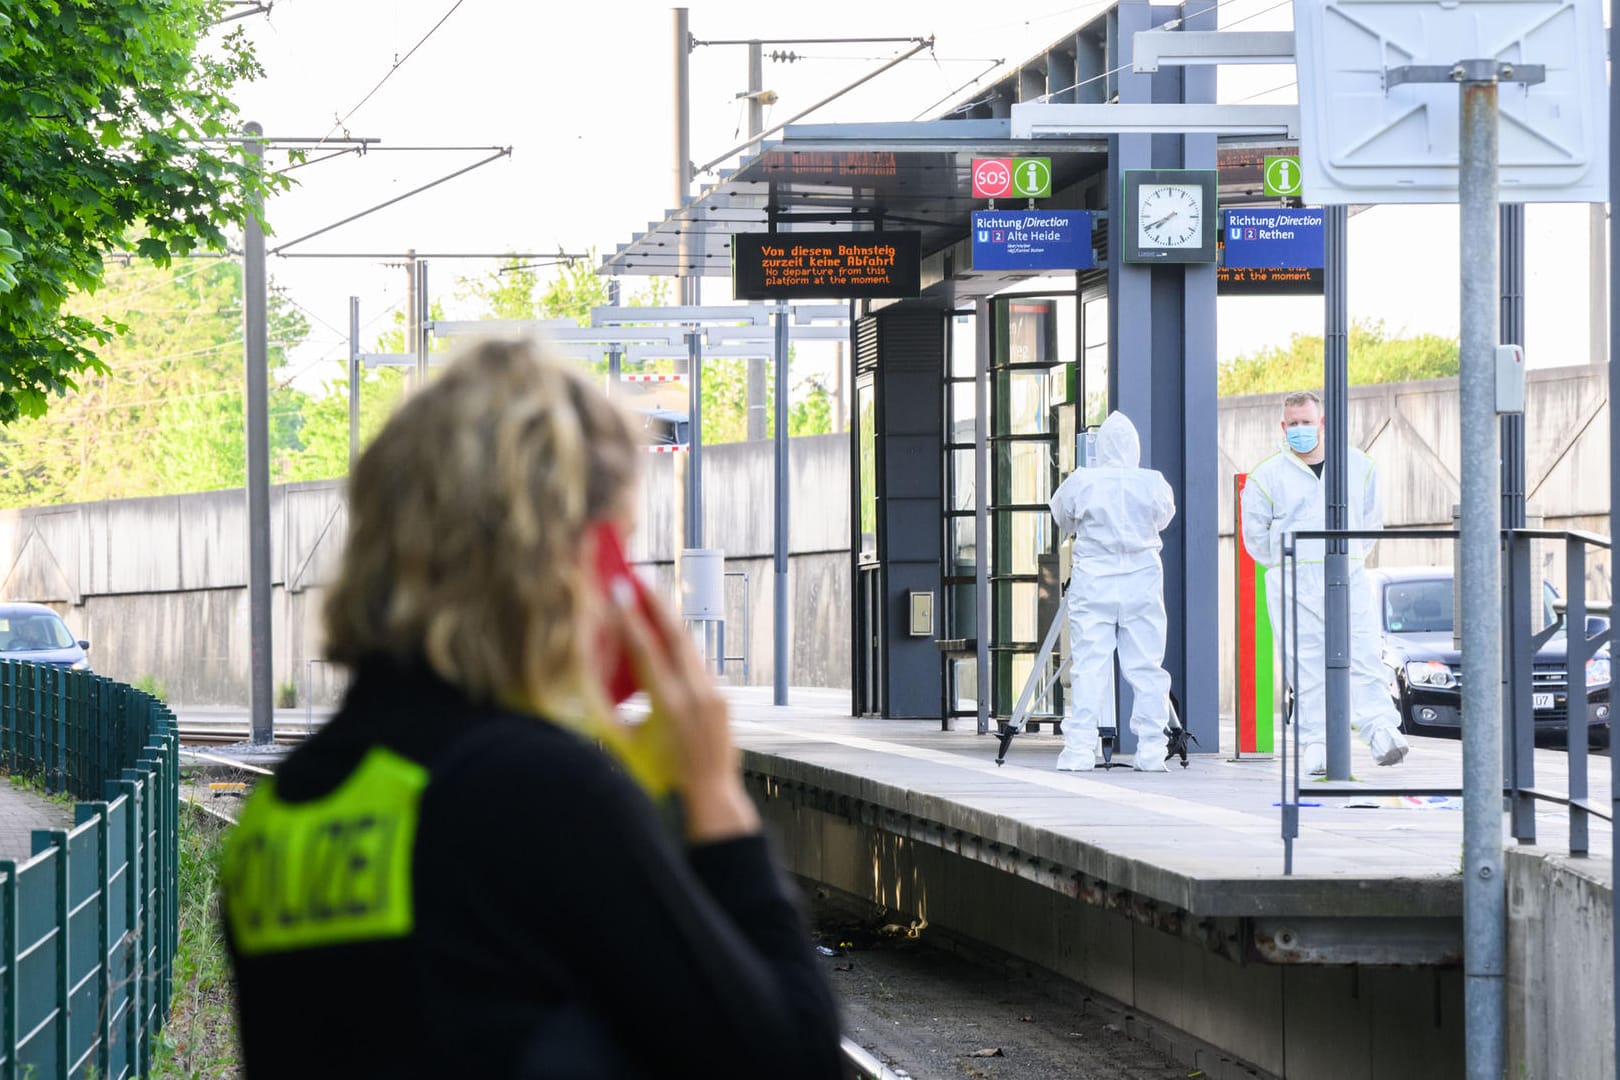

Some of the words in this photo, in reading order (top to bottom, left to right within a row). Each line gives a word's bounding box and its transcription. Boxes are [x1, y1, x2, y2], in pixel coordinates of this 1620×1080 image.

[977, 171, 1007, 185] SOS
[977, 217, 1069, 230] Richtung/Direction
[1229, 215, 1322, 228] Richtung/Direction
[978, 230, 988, 242] U
[1007, 231, 1028, 241] Alte
[1031, 231, 1061, 241] Heide
[1231, 228, 1241, 240] U
[1259, 229, 1295, 240] Rethen
[761, 245, 785, 256] Von
[791, 246, 833, 256] diesem
[838, 244, 896, 257] Bahnsteig
[761, 256, 803, 267] zurzeit
[809, 256, 841, 267] keine
[847, 255, 895, 267] Abfahrt
[765, 268, 778, 276] No
[782, 267, 834, 277] departure
[839, 267, 862, 277] from
[866, 266, 886, 275] this
[1234, 272, 1245, 281] at
[1250, 271, 1267, 281] the
[1271, 271, 1312, 281] moment
[765, 276, 809, 286] platform
[814, 276, 825, 285] at
[830, 275, 847, 284] the
[851, 275, 890, 284] moment
